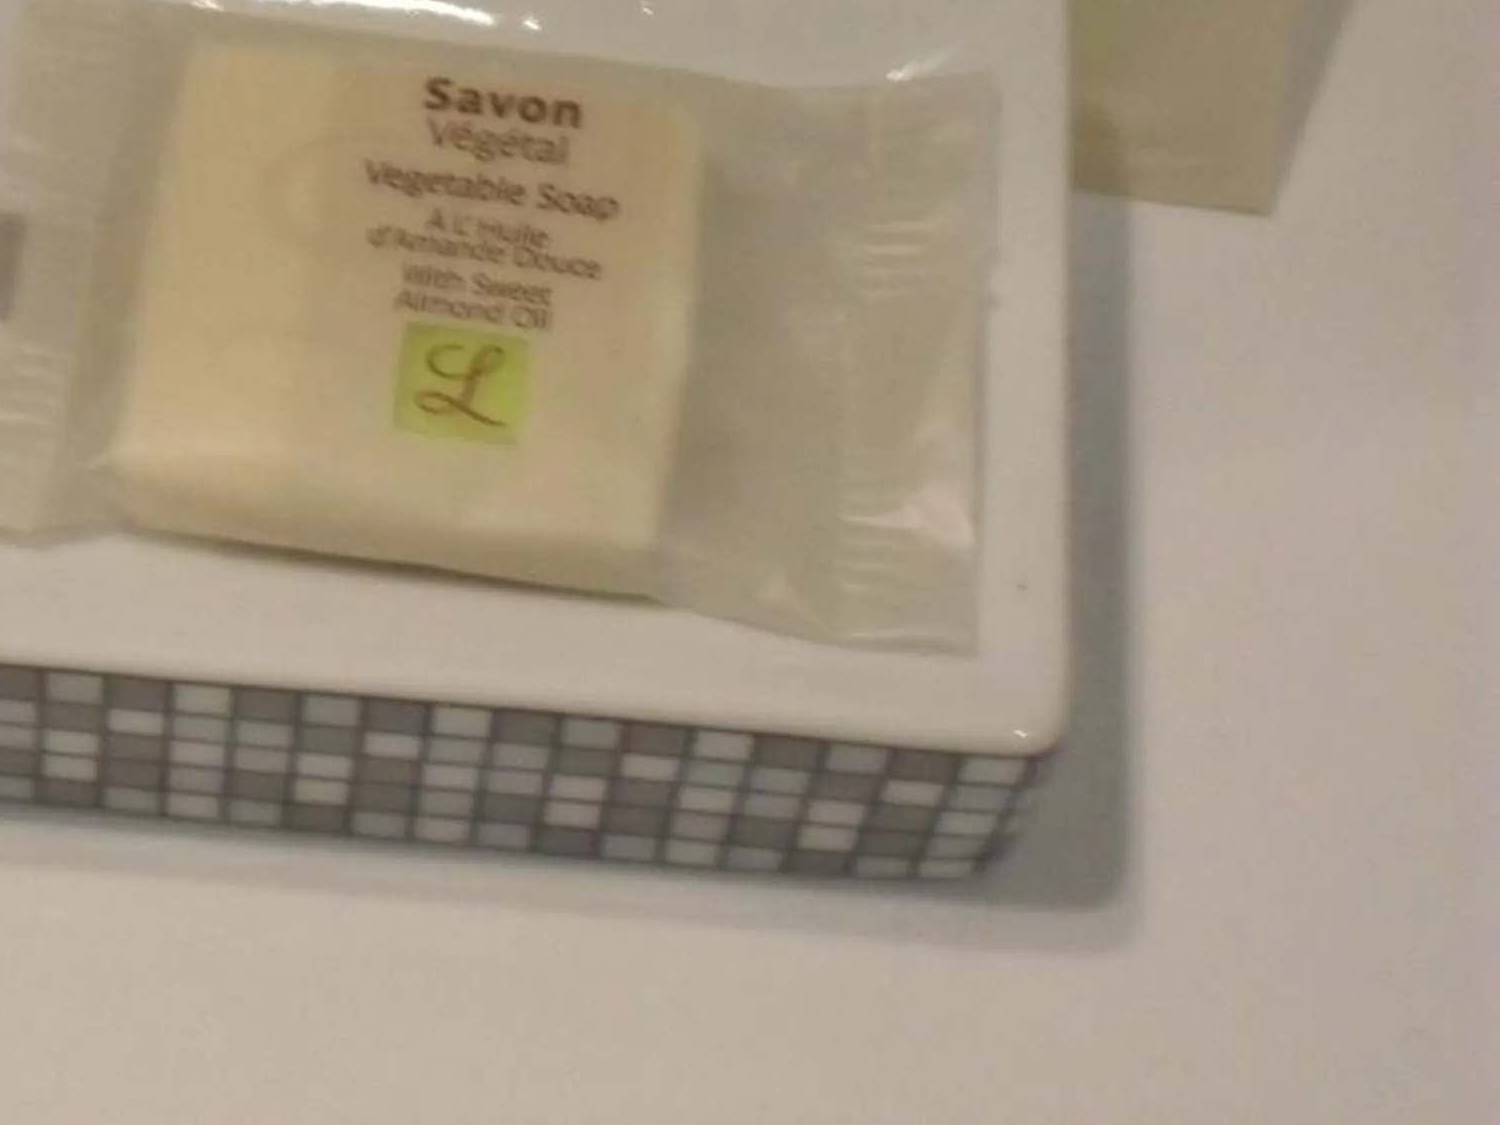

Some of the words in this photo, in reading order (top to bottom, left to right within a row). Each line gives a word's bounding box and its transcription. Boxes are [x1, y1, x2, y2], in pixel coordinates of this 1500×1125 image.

[423, 76, 583, 128] Savon
[365, 158, 526, 205] Vegetable
[536, 183, 621, 220] Soap
[513, 247, 602, 279] Douce
